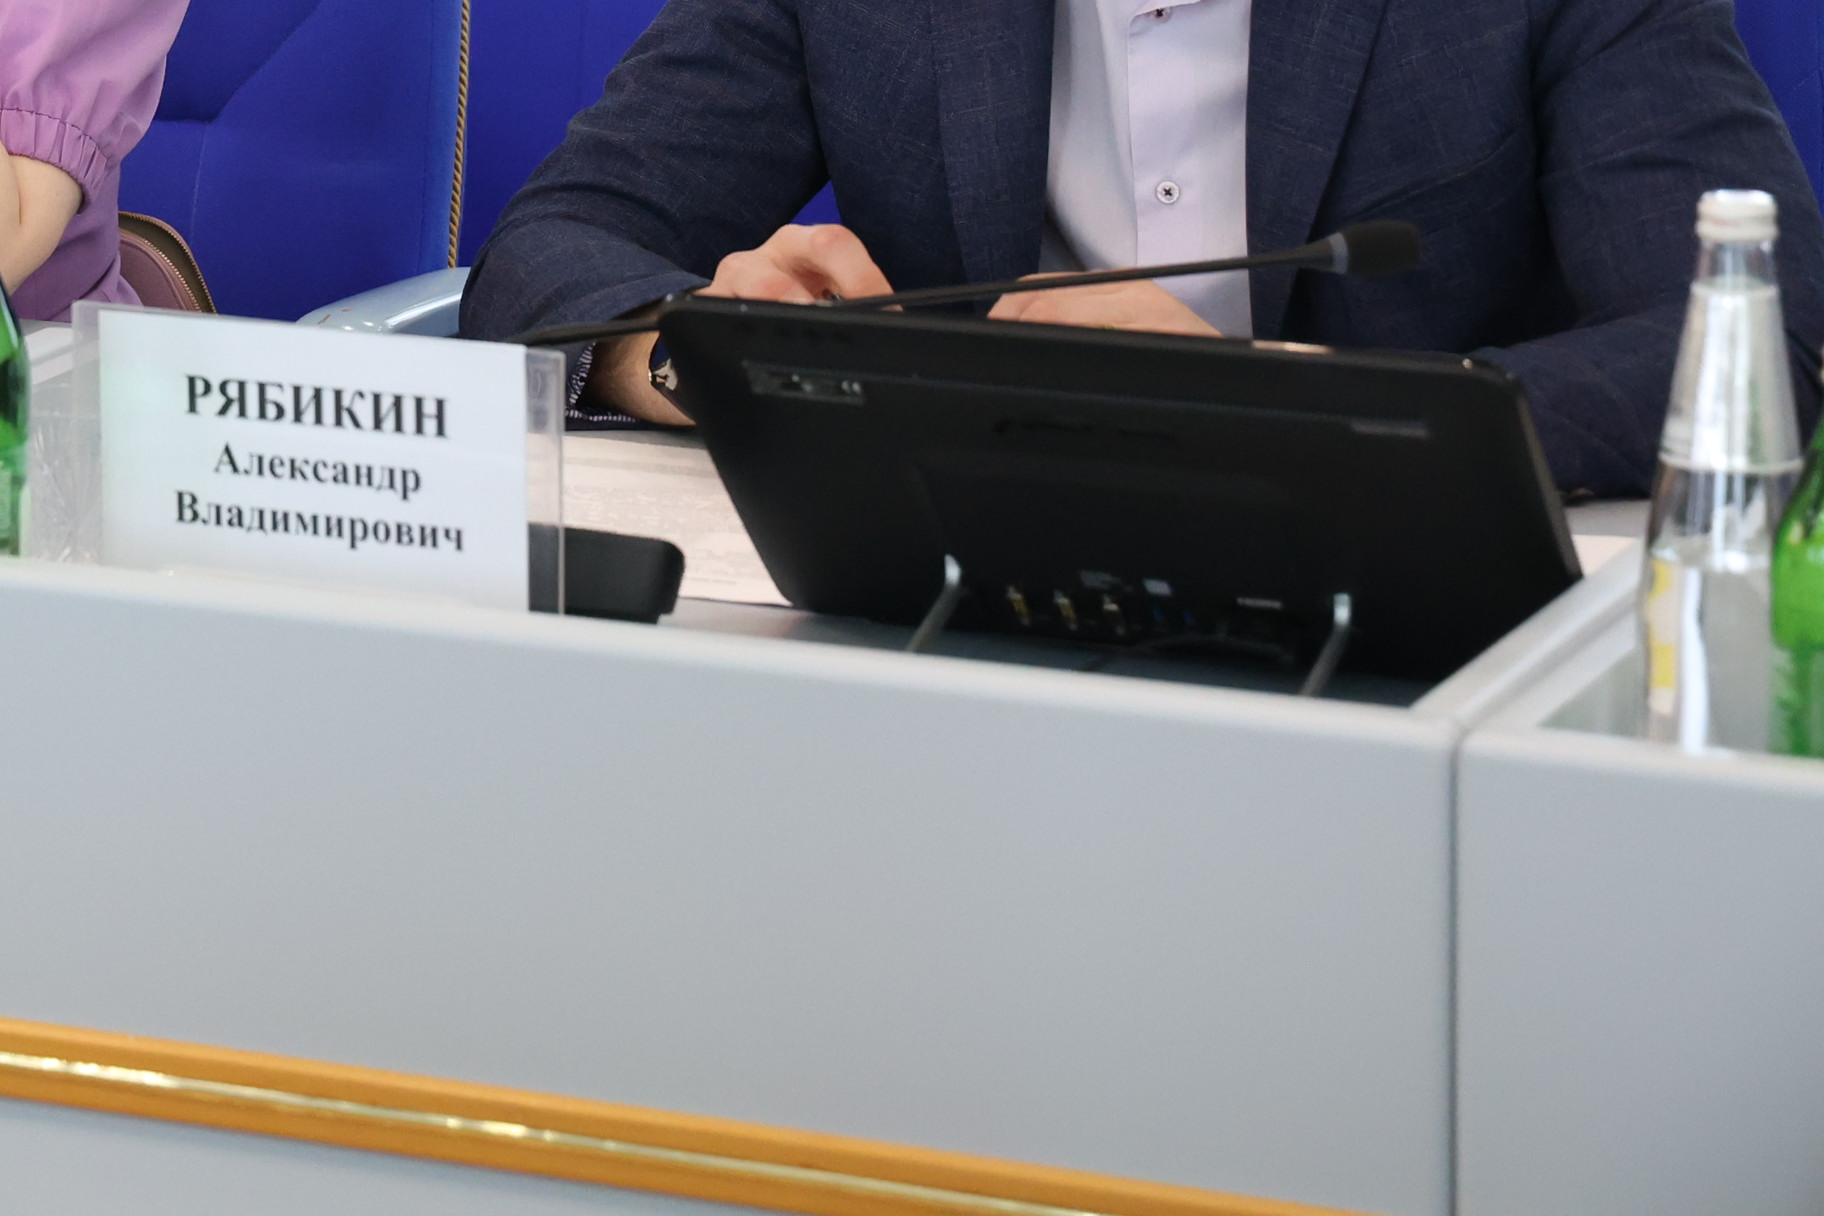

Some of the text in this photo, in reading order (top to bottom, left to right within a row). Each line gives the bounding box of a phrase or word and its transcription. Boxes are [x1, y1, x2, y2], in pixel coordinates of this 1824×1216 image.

[185, 374, 448, 439] РЯБИКИН
[214, 441, 422, 502] Александр
[175, 490, 465, 552] Владимирович
